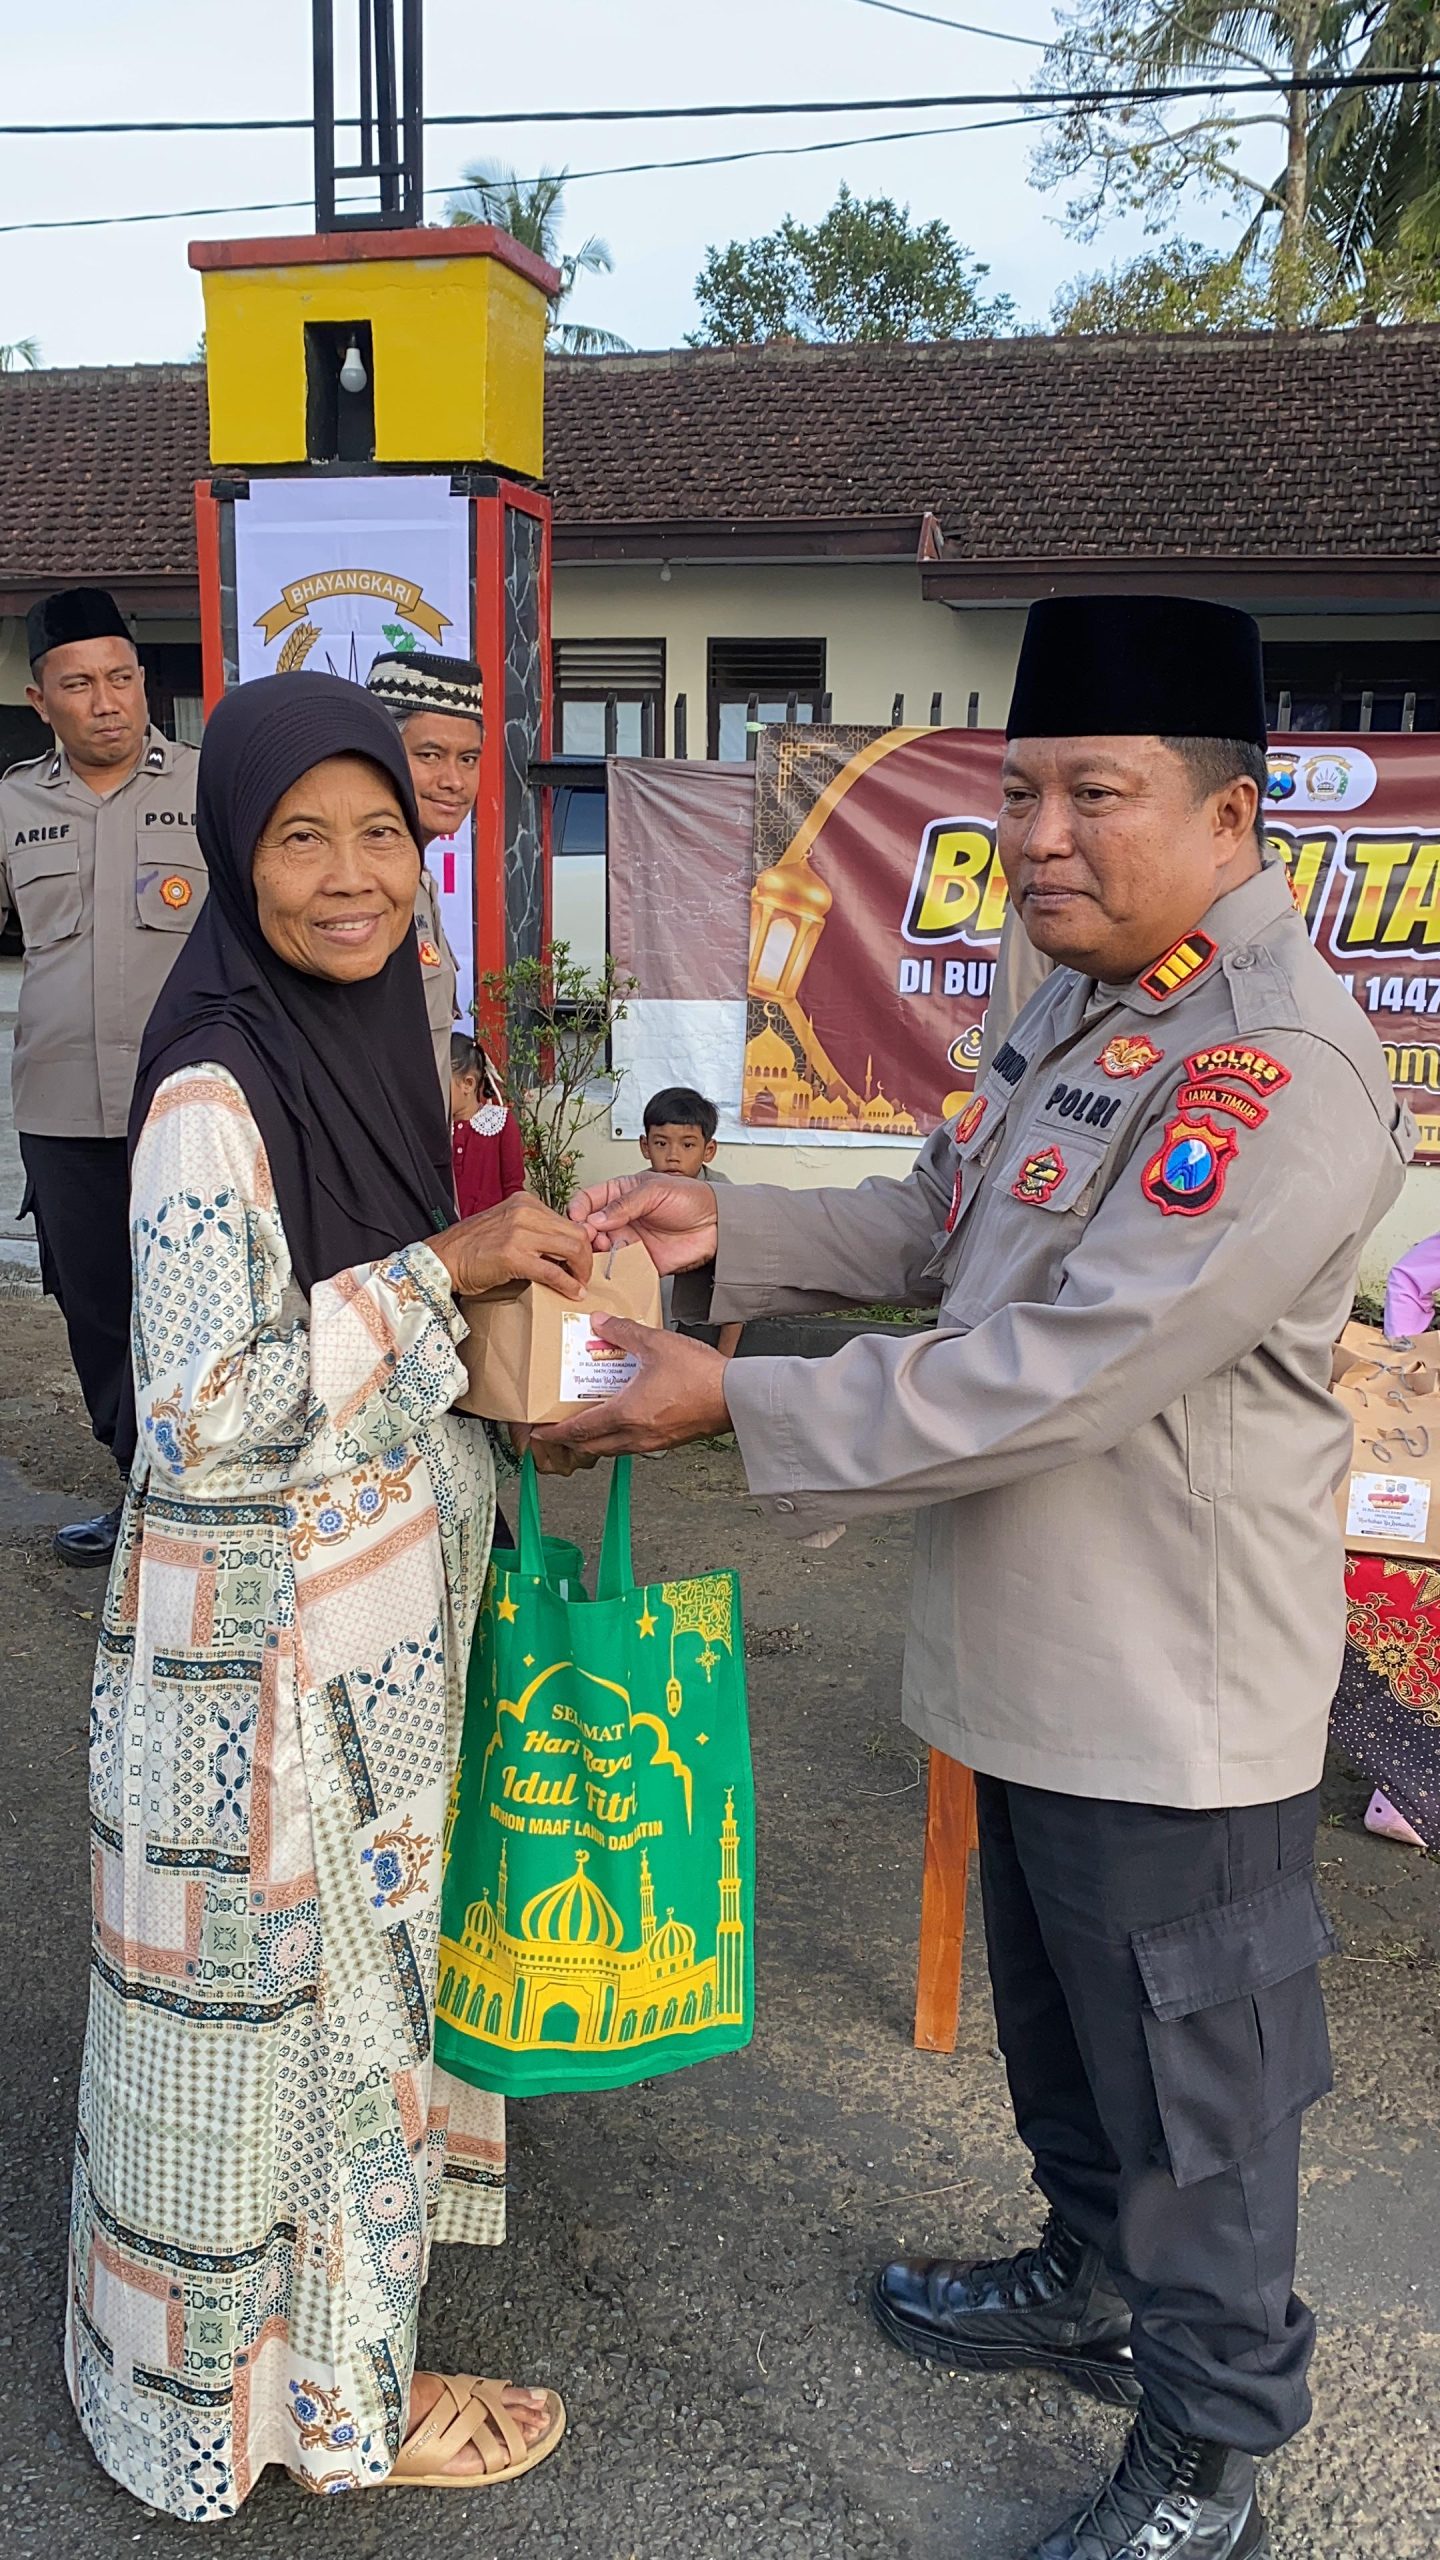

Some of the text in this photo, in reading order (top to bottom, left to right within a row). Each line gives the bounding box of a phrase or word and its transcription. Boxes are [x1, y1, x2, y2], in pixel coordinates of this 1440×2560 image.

[290, 573, 412, 604] BHAYANGKARI
[15, 824, 70, 846] ARIEF
[899, 959, 933, 994] DI
[944, 961, 996, 995] BU
[1196, 1050, 1279, 1081] POLRES
[1208, 1062, 1261, 1079] BLITAR
[1045, 1083, 1121, 1128] POLRI
[1220, 1092, 1258, 1119] TIMUR
[523, 1730, 580, 1755] Hari
[502, 1766, 638, 1823] Idul Fitri
[528, 1818, 571, 1835] MAAF
